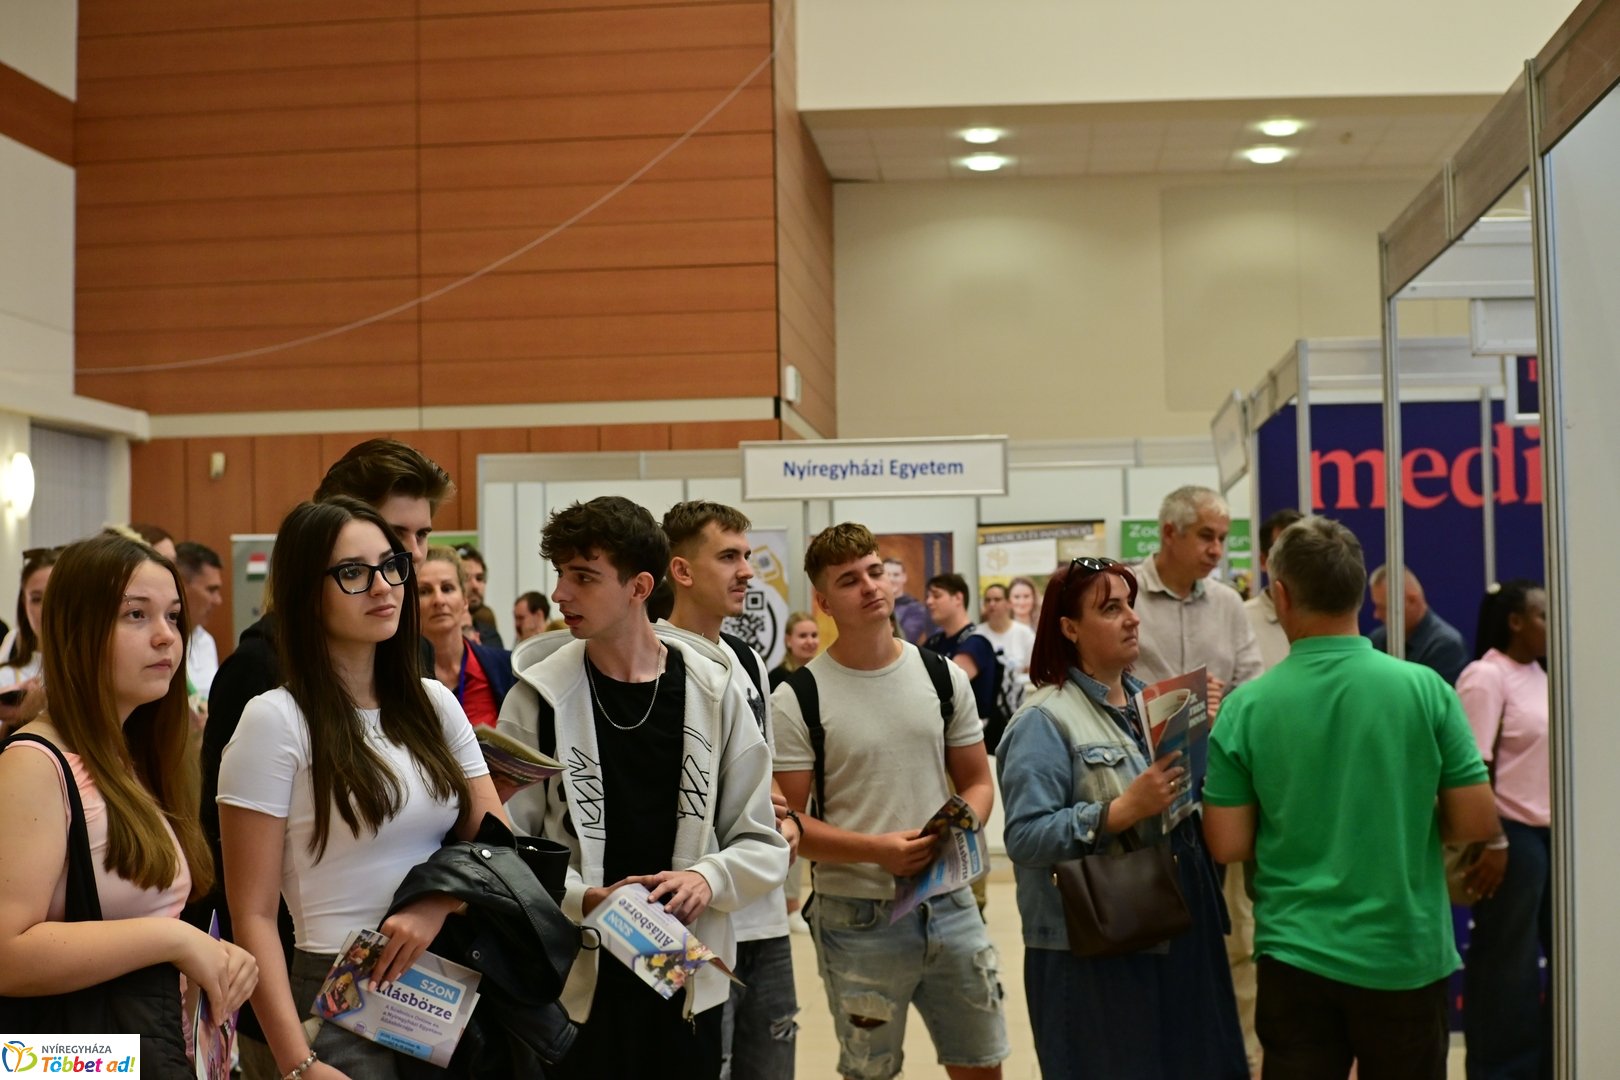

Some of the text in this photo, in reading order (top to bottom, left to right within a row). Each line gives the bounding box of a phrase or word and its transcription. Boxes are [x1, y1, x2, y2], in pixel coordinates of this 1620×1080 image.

[783, 458, 964, 481] Nyíregyházi Egyetem
[618, 899, 674, 949] Állásbörze
[376, 984, 453, 1020] lásbörze
[420, 979, 455, 1001] SZON
